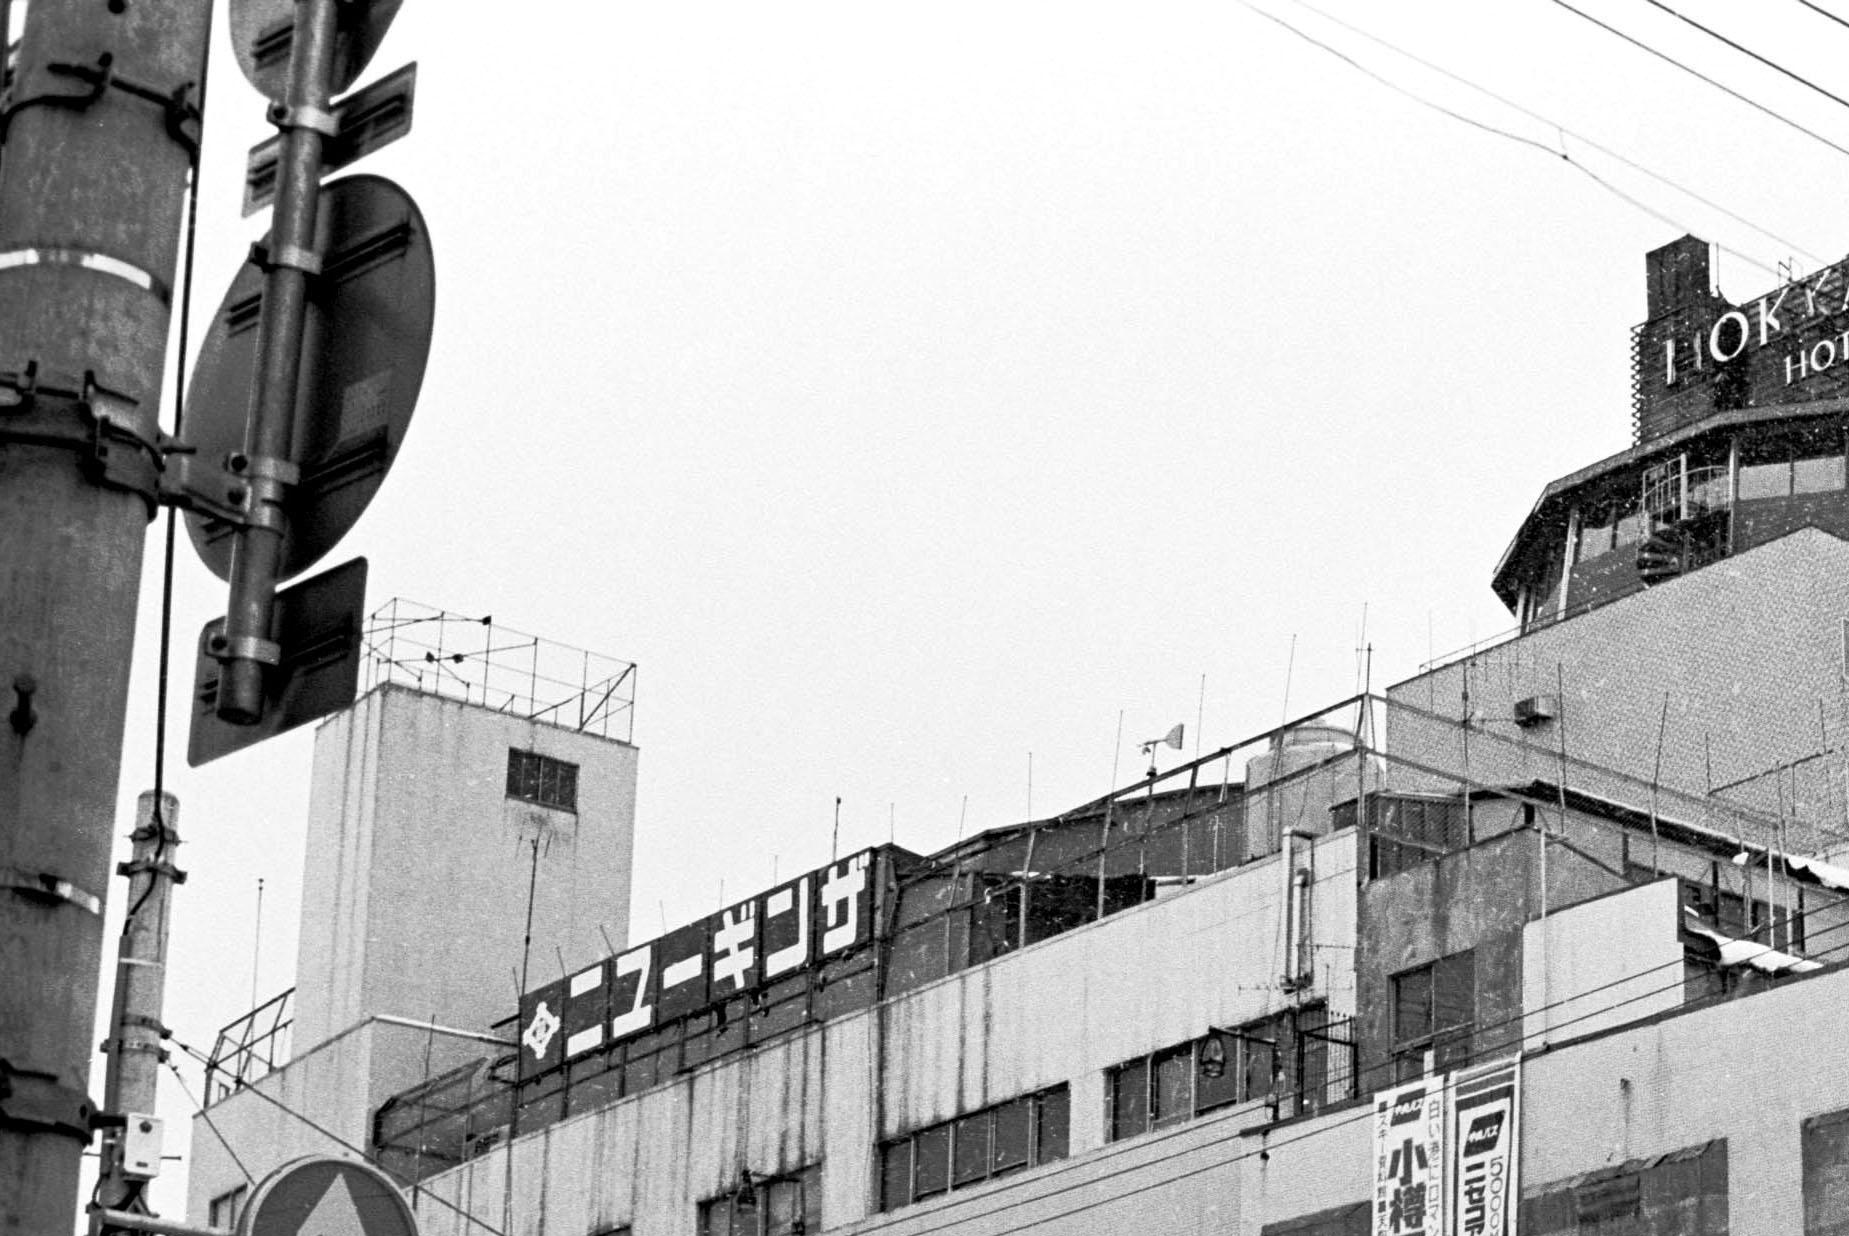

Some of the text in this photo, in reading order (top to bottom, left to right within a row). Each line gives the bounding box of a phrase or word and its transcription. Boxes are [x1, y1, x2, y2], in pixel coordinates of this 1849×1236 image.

[566, 850, 871, 1058] ニューギンザ
